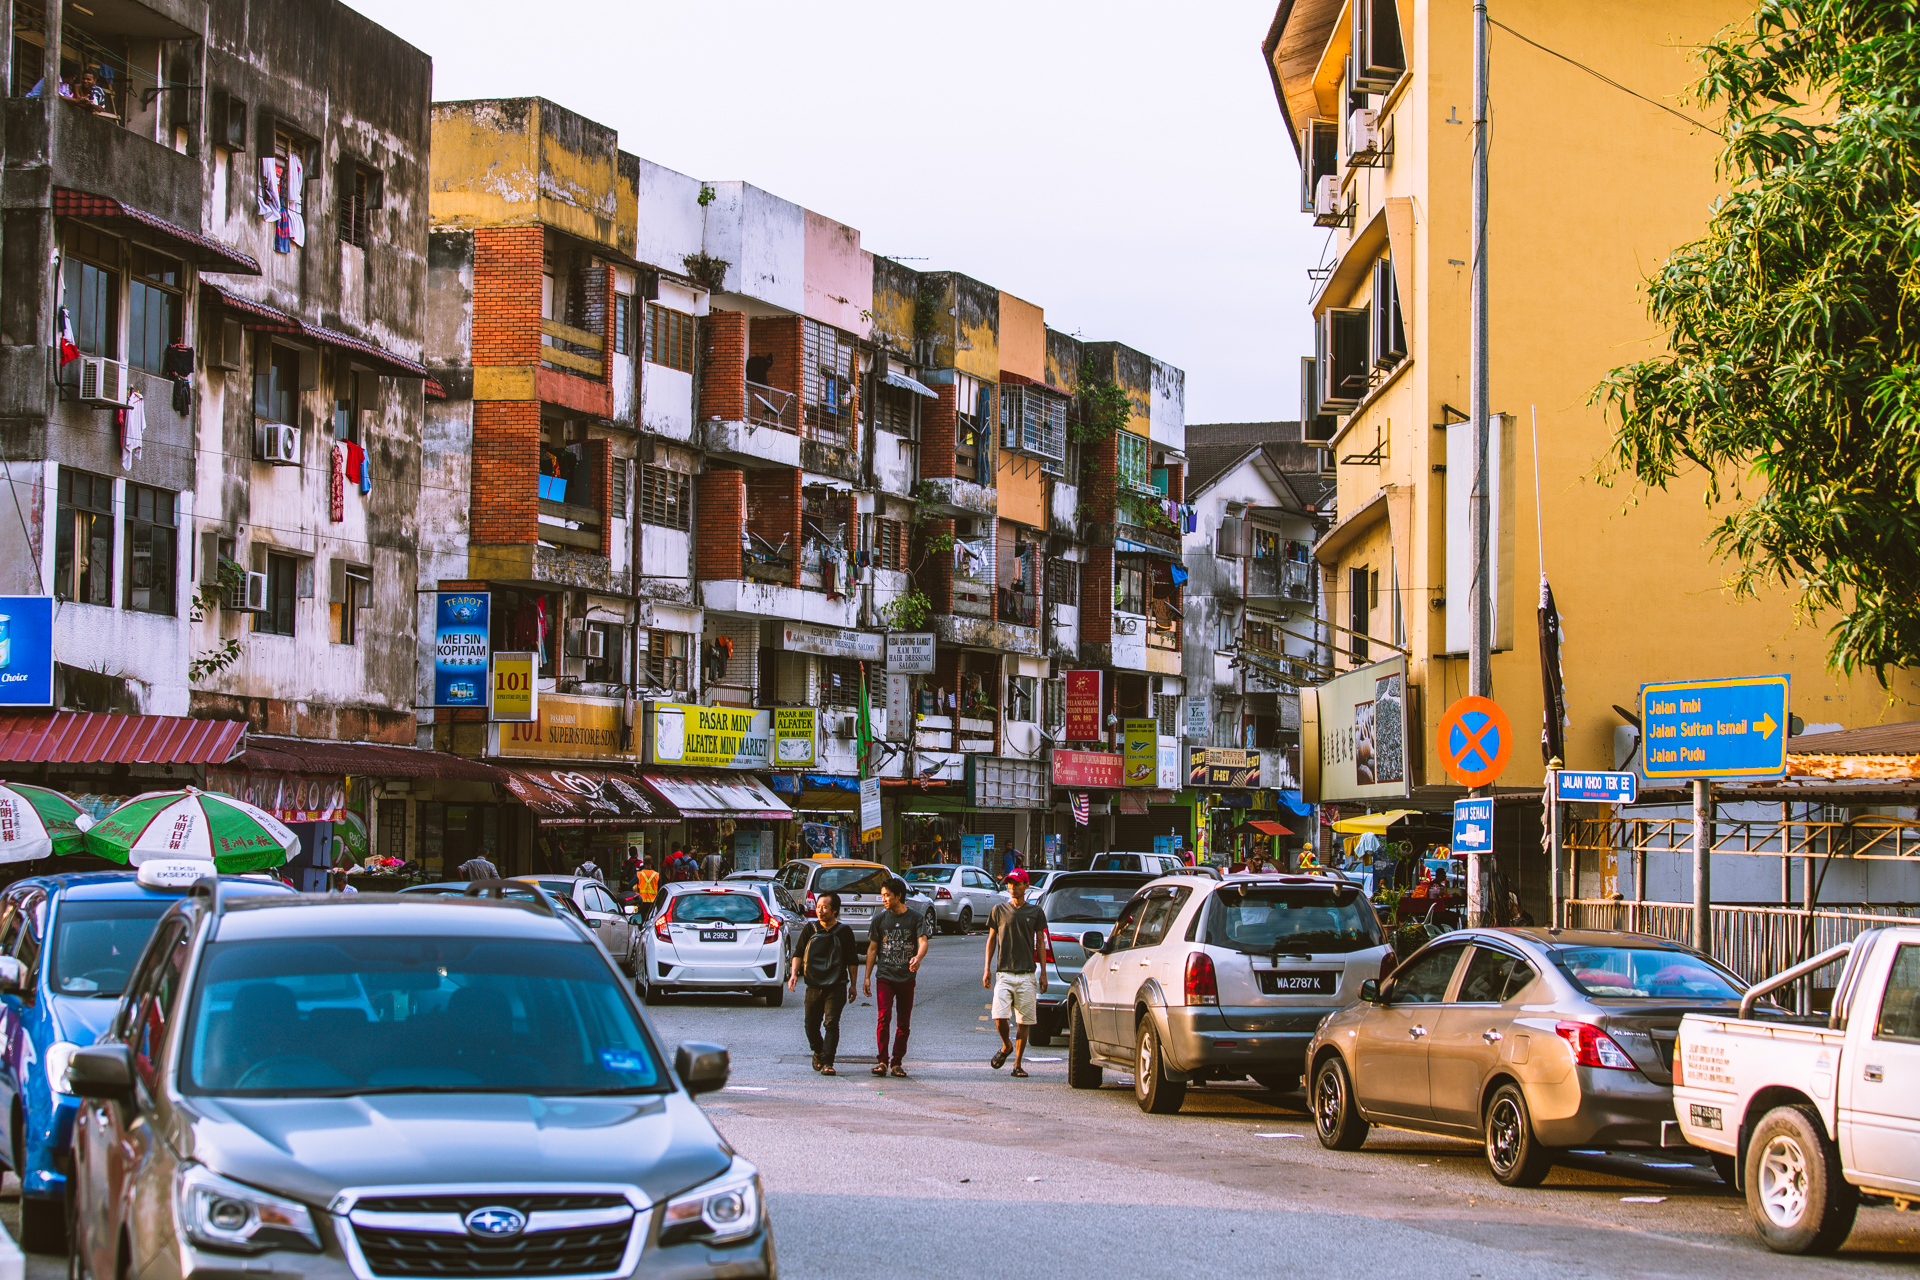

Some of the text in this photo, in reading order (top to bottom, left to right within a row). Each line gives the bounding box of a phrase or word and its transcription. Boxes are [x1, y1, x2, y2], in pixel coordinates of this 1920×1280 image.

[444, 597, 483, 607] TEAPOT
[442, 634, 480, 644] MEI SIN
[437, 646, 486, 656] KOPITIAM
[2, 673, 28, 682] Choice
[497, 672, 530, 690] 101
[1649, 698, 1701, 715] Jalan Imbi
[699, 712, 728, 730] PASAR
[731, 714, 752, 732] MINI
[778, 719, 813, 729] ALFATEK
[1650, 719, 1748, 738] Jalan Sultan Ismail
[549, 726, 574, 744] SUPER
[575, 728, 600, 745] STORE
[601, 730, 618, 746] SDN.
[686, 734, 767, 757] ALFATEK MINI MARKET
[1650, 747, 1705, 762] Jalan Pudu
[1562, 776, 1583, 789] JALAN
[1585, 776, 1602, 789] KHOO
[1621, 777, 1630, 790] EE
[1470, 806, 1489, 820] SEHALA
[169, 814, 188, 850] 光明日報
[235, 855, 255, 863] CHEW
[257, 852, 278, 861] DAILY
[1276, 978, 1320, 988] WA 2787 K
